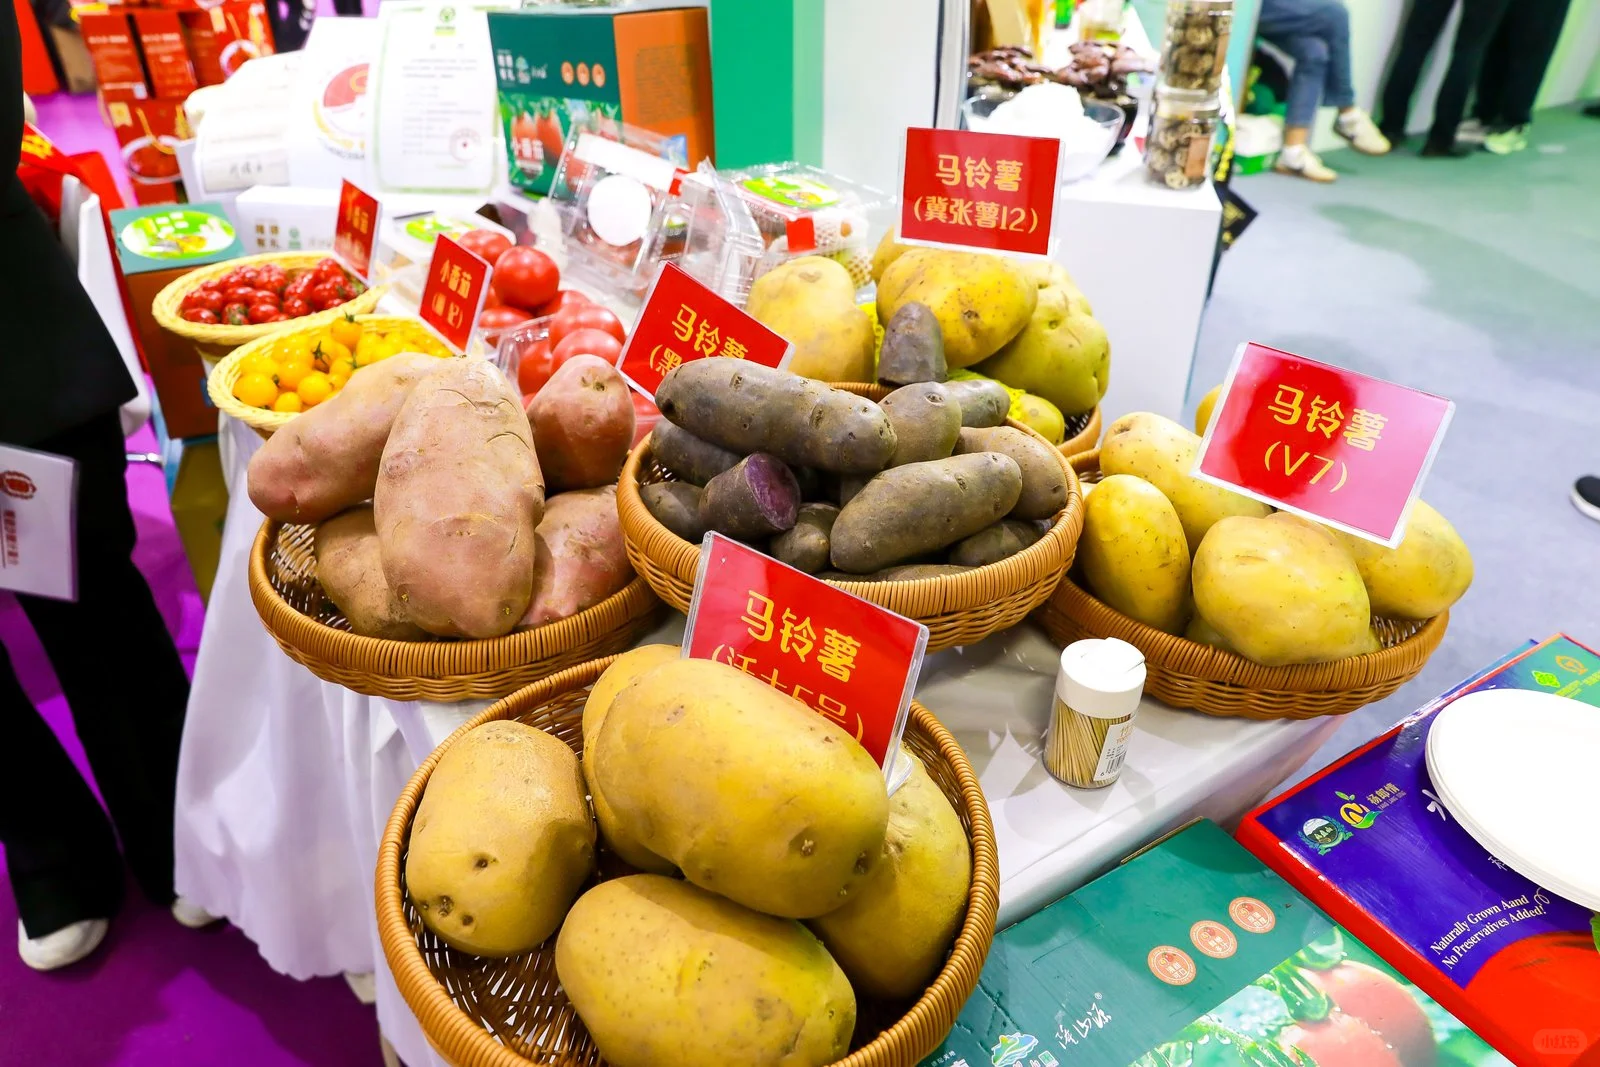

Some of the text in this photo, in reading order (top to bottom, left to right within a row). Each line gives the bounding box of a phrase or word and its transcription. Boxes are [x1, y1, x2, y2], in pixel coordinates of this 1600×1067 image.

[935, 154, 1023, 192] 马铃薯
[913, 196, 1039, 234] (冀张薯12)
[439, 259, 473, 299] 小番茄
[1267, 384, 1388, 452] 马铃薯
[1264, 440, 1348, 493] (V7)
[740, 589, 862, 683] 马铃薯
[1430, 894, 1530, 956] Naturally Grown Aand
[1441, 905, 1547, 970] No Preservatives Added!
